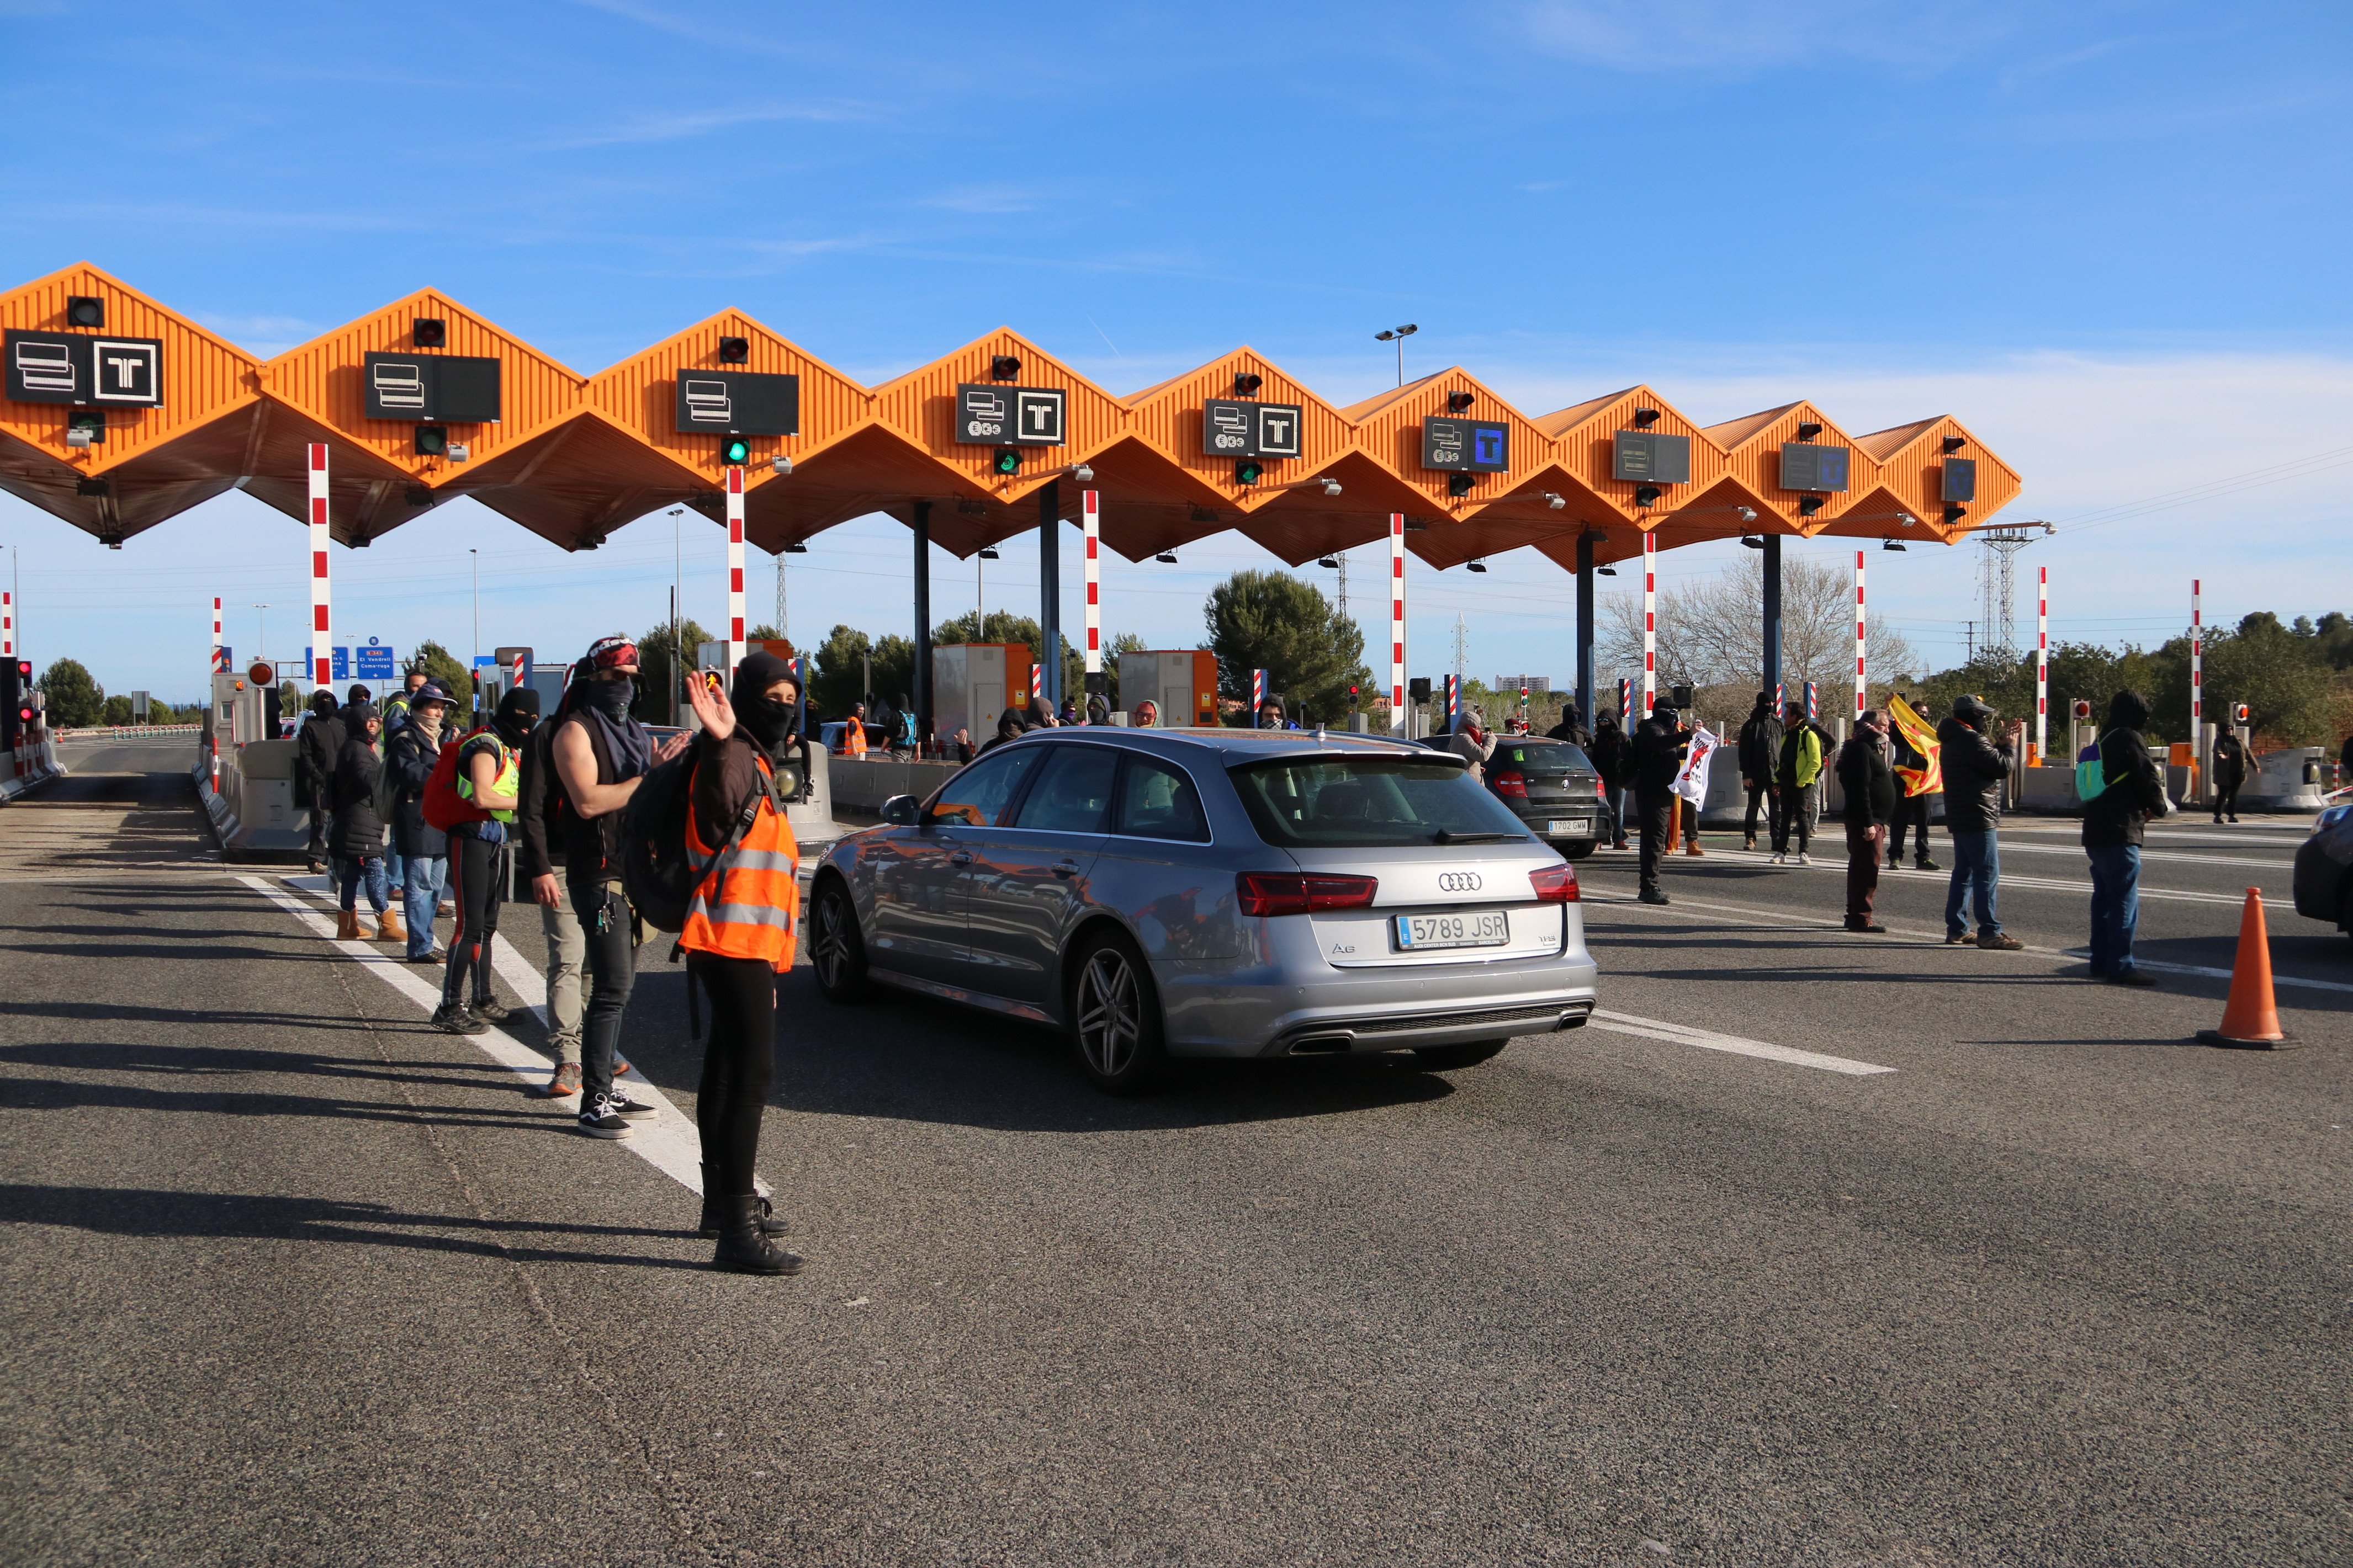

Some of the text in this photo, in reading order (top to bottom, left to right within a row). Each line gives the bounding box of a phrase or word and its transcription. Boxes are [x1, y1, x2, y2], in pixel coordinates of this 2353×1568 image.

[1478, 435, 1499, 459] T
[1573, 821, 1586, 830] GMM
[1413, 916, 1504, 940] 5789 JSR
[1332, 943, 1355, 954] A6
